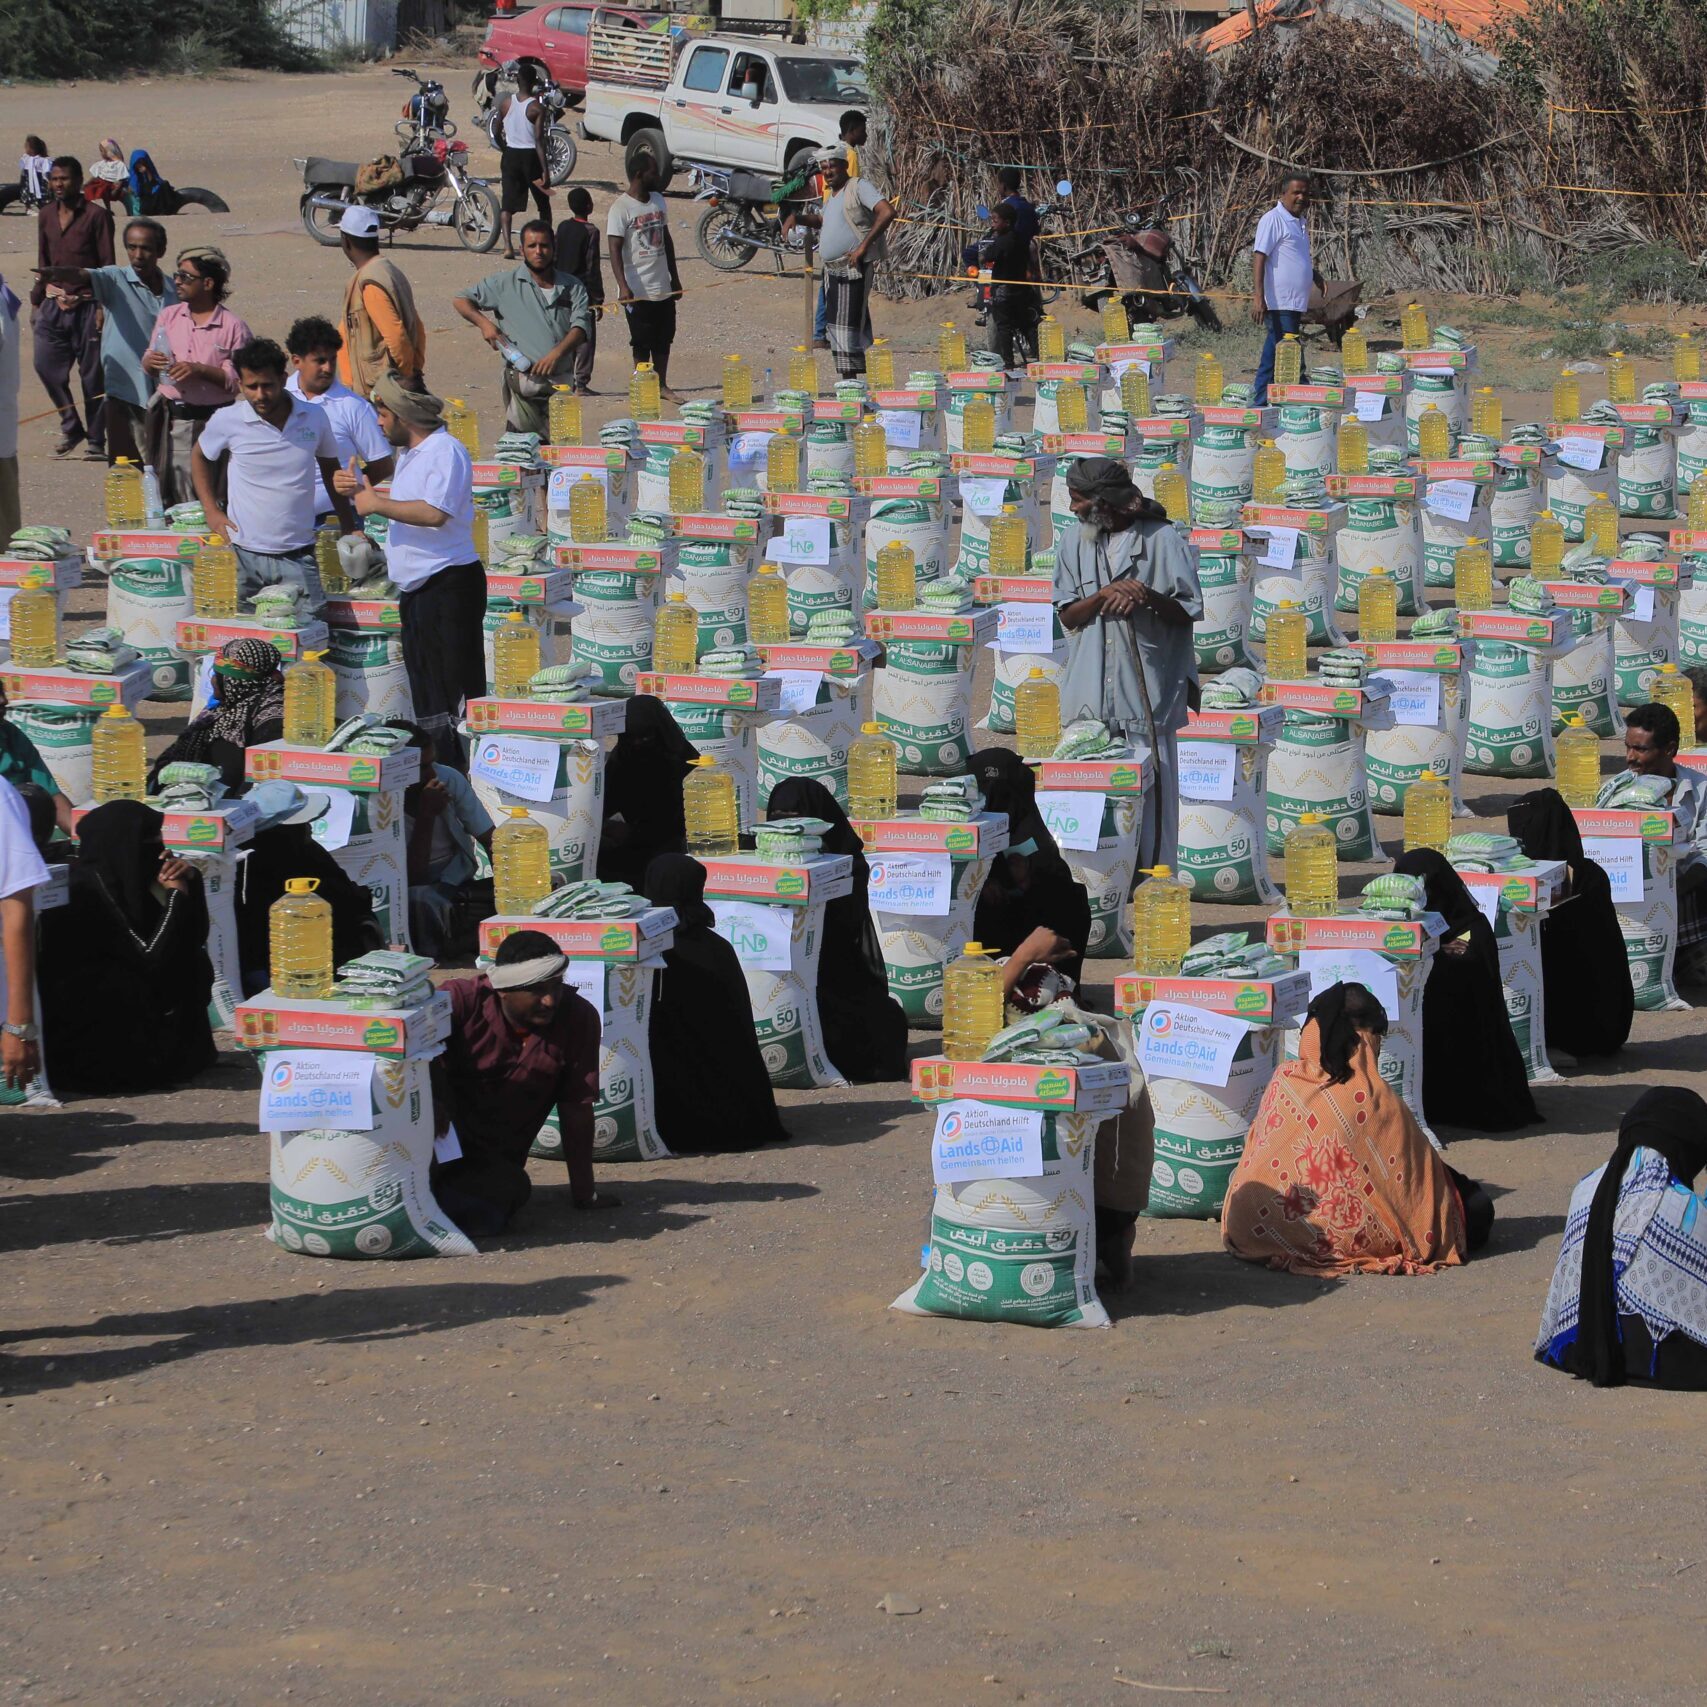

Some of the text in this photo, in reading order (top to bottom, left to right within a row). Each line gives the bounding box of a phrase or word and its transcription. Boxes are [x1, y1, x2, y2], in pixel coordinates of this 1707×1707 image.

[706, 523, 728, 531] فاصوليا
[925, 561, 936, 570] 50
[1397, 566, 1408, 575] 50
[837, 590, 849, 598] 50
[806, 596, 834, 606] دقيق
[1308, 596, 1319, 605] 50
[727, 608, 740, 616] 50
[923, 624, 943, 632] فاصوليا
[1027, 629, 1040, 638] Aid
[1229, 625, 1240, 634] 50
[1498, 624, 1521, 632] فاصوليا
[1197, 635, 1226, 645] دقيق
[578, 642, 631, 660] دقيق أبيض
[635, 642, 648, 651] 50
[777, 654, 824, 663] فاصوليا حمراء
[1652, 649, 1664, 659] 50
[899, 657, 943, 668] ALSANABEL
[1620, 657, 1649, 668] دقيق
[673, 684, 722, 693] فاصوليا حمراء
[1591, 679, 1603, 690] 50
[1283, 693, 1329, 702] فاصوليا حمراء
[1557, 690, 1588, 700] دقيق
[1410, 700, 1426, 709] Aid
[506, 710, 556, 721] فاصوليا حمراء
[890, 723, 948, 739] دقيق أبيض
[1525, 720, 1537, 732] 50
[1289, 729, 1335, 739] ALSANABEL
[1490, 731, 1522, 743] دقيق
[502, 747, 520, 755] Aktion
[830, 750, 844, 762] 50
[502, 755, 550, 766] Deutschland Hilft
[766, 754, 827, 772] دقيق أبيض
[1432, 759, 1446, 770] 50
[289, 761, 343, 772] فاصوليا حمراء
[1369, 762, 1392, 775] أبيض
[477, 762, 541, 785] Lands Aid
[1050, 771, 1104, 780] فاصوليا حمراء
[1202, 772, 1220, 784] Aid
[1350, 793, 1362, 804] 50
[1281, 801, 1347, 814] دقيق أبيض
[1580, 819, 1633, 829] فاصوليا حمراء
[884, 831, 938, 842] فاصوليا حمراء
[563, 843, 579, 854] 50
[1231, 839, 1245, 852] 50
[1191, 851, 1227, 864] دقيق
[1619, 855, 1633, 863] Hilft
[713, 874, 768, 885] فاصوليا حمراء
[887, 870, 942, 878] Deutschland Hilft
[1609, 872, 1627, 883] Aid
[915, 886, 935, 899] Aid
[1103, 893, 1117, 904] 50
[1315, 929, 1376, 940] فاصوليا حمراء
[900, 969, 941, 984] دقيق
[1164, 989, 1226, 1002] فاصوليا حمراء
[1511, 996, 1526, 1009] 50
[776, 1009, 794, 1025] 50
[1175, 1012, 1198, 1023] Aktion
[288, 1023, 355, 1036] فاصوليا حمراء
[1173, 1023, 1213, 1036] Deutschland
[1214, 1030, 1231, 1040] Hilft
[1146, 1038, 1183, 1056] Lands
[1200, 1045, 1217, 1062] Aid
[296, 1062, 320, 1070] Aktion
[1144, 1054, 1214, 1072] Gemeinsam helfen
[1381, 1061, 1398, 1074] 50
[295, 1071, 360, 1080] Deutschland Hilft
[963, 1074, 1028, 1088] فاصوليا حمراء
[609, 1080, 628, 1096] 50
[268, 1091, 352, 1107] Lands Aid
[965, 1109, 988, 1118] Aktion
[964, 1116, 1029, 1129] Deutschland Hilft
[940, 1136, 1023, 1158] Lands Aid
[1155, 1138, 1243, 1159] دقيق أبيض
[941, 1156, 1025, 1170] Gemeinsam helfen
[280, 1202, 368, 1226] دقيق أبيض
[950, 1229, 1043, 1252] دقيق أبيض
[1048, 1231, 1070, 1244] 50
